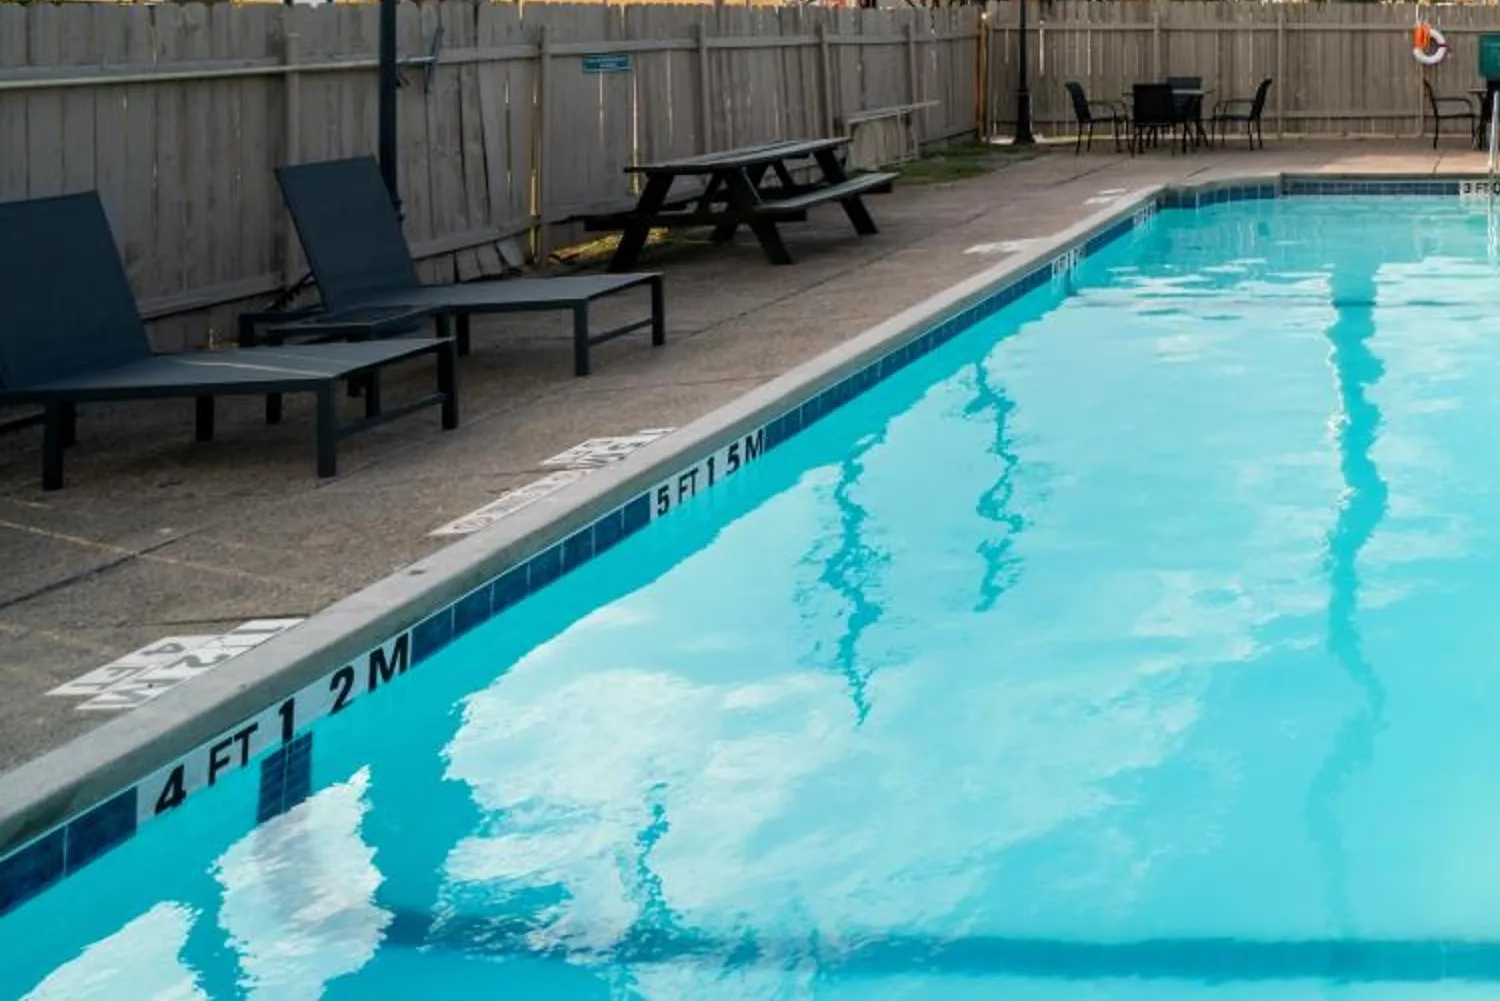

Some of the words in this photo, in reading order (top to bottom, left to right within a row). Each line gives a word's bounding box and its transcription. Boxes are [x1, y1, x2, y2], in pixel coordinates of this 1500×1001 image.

[678, 468, 698, 505] FT
[155, 764, 188, 815] 4
[208, 722, 259, 786] FT
